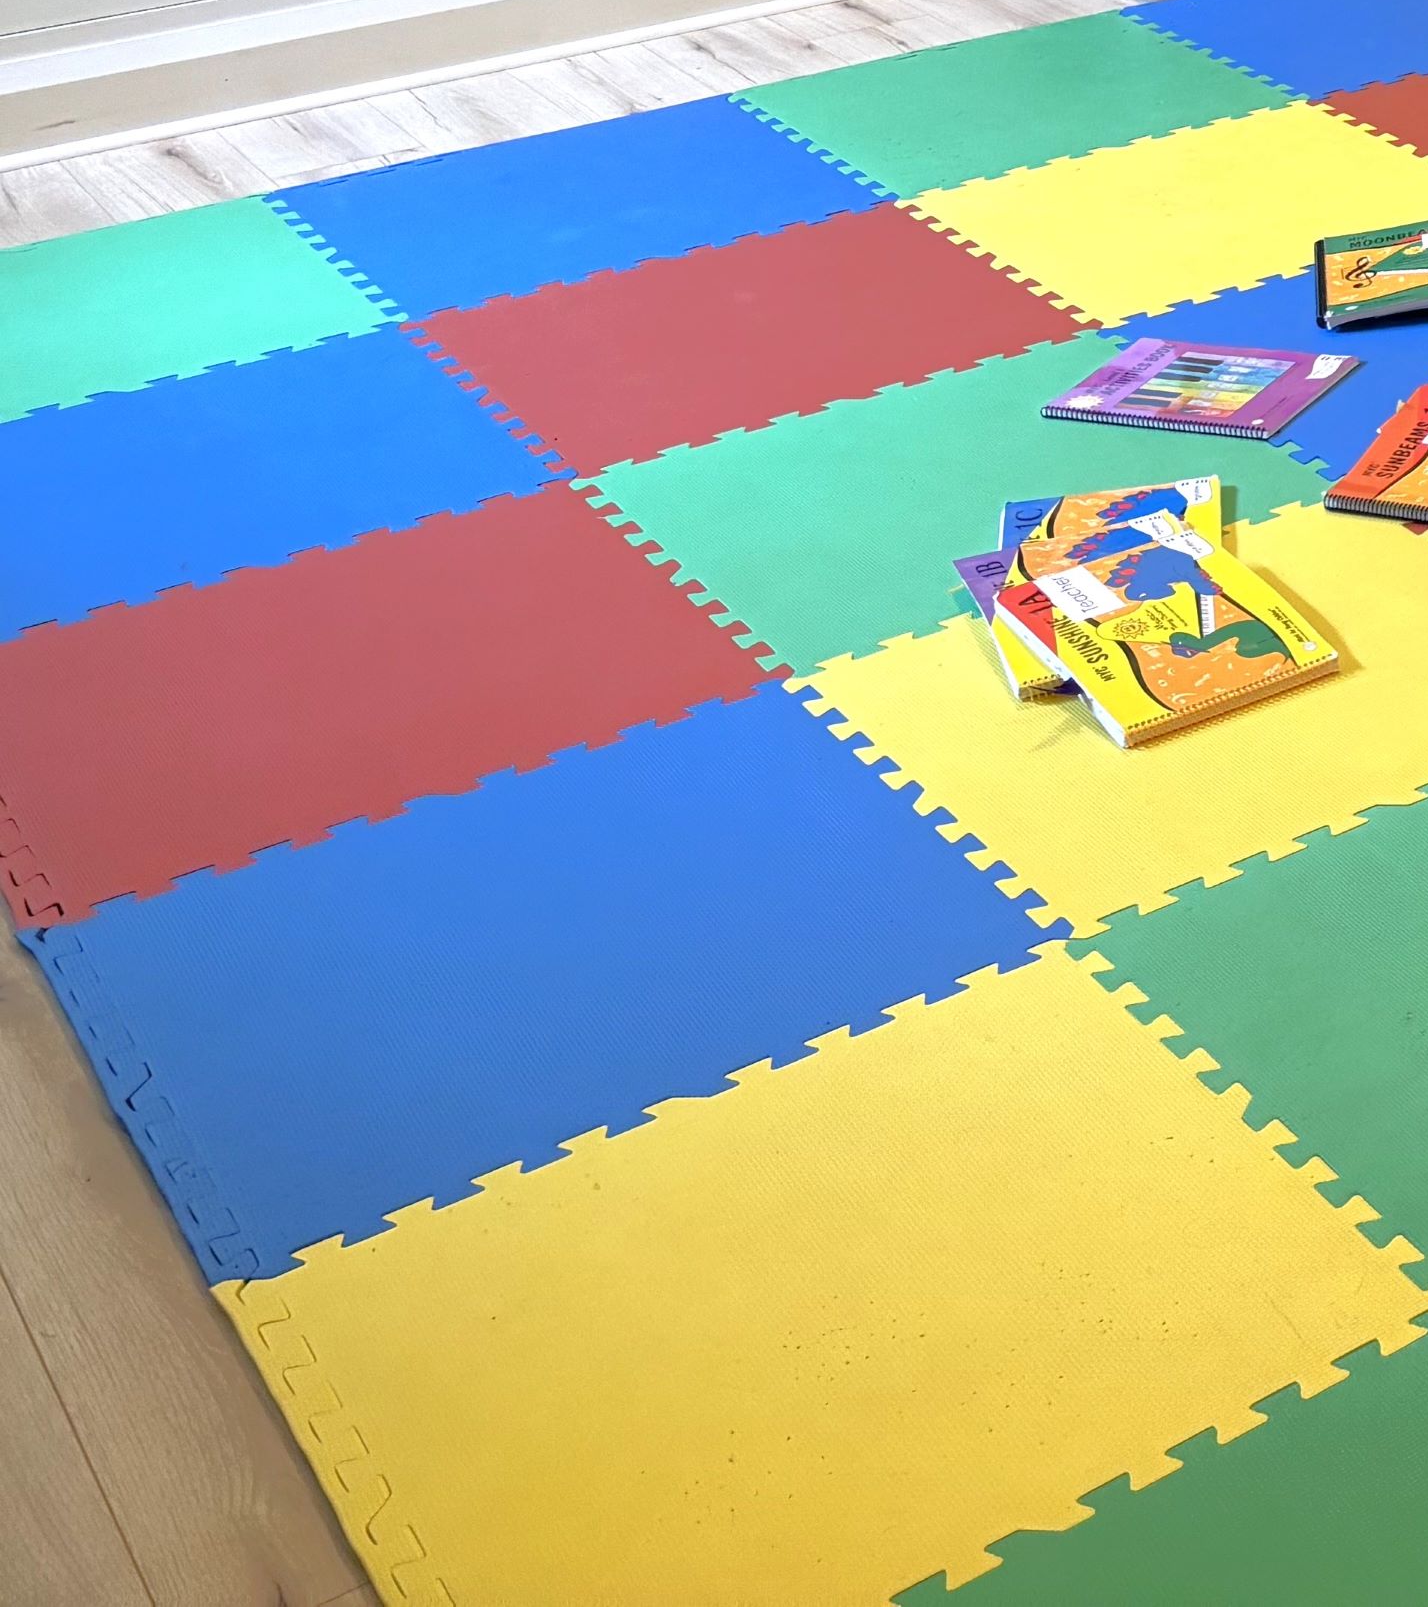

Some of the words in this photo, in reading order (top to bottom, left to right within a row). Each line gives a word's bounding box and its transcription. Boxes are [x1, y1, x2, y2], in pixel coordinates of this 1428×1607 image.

[1014, 507, 1043, 530] 1C
[975, 560, 1008, 579] 1B
[1018, 590, 1057, 617] 1A
[1051, 576, 1099, 614] Teacher
[1046, 614, 1110, 664] SUNSHINE
